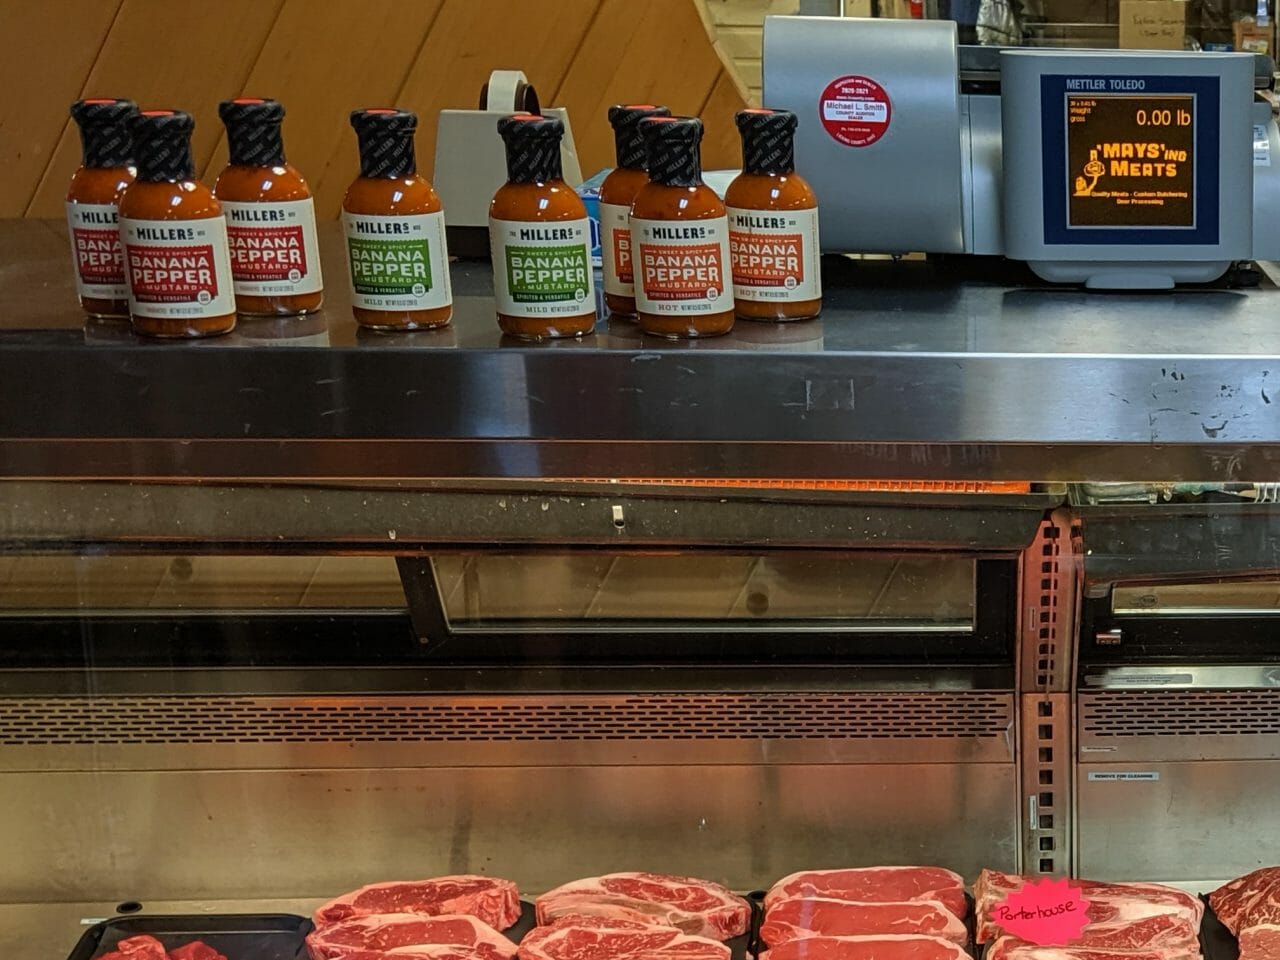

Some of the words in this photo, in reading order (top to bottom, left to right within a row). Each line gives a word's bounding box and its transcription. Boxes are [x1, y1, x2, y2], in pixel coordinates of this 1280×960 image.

[1067, 79, 1105, 89] METTLER
[1109, 79, 1145, 89] TOLEDO
[1136, 110, 1171, 125] 0.00
[1177, 109, 1191, 126] lb
[1111, 160, 1177, 177] MEATS
[231, 210, 285, 221] MILLERS
[736, 215, 786, 228] MILLERS
[137, 228, 194, 240] MILLERS
[356, 221, 410, 234] MILLERS
[520, 228, 573, 240] MILLERS
[652, 227, 706, 239] MILLERS
[228, 235, 299, 248] BANANA
[351, 249, 424, 261] BANANA
[731, 242, 798, 255] BANANA
[131, 256, 209, 269] BANANA
[229, 249, 302, 264] PEPPER
[511, 256, 584, 268] BANANA
[644, 254, 717, 266] BANANA
[732, 254, 799, 272] PEPPER
[133, 268, 212, 285] PEPPER
[353, 261, 426, 279] PEPPER
[512, 268, 586, 285] PEPPER
[646, 266, 719, 283] PEPPER
[998, 901, 1077, 920] Porterhouse
